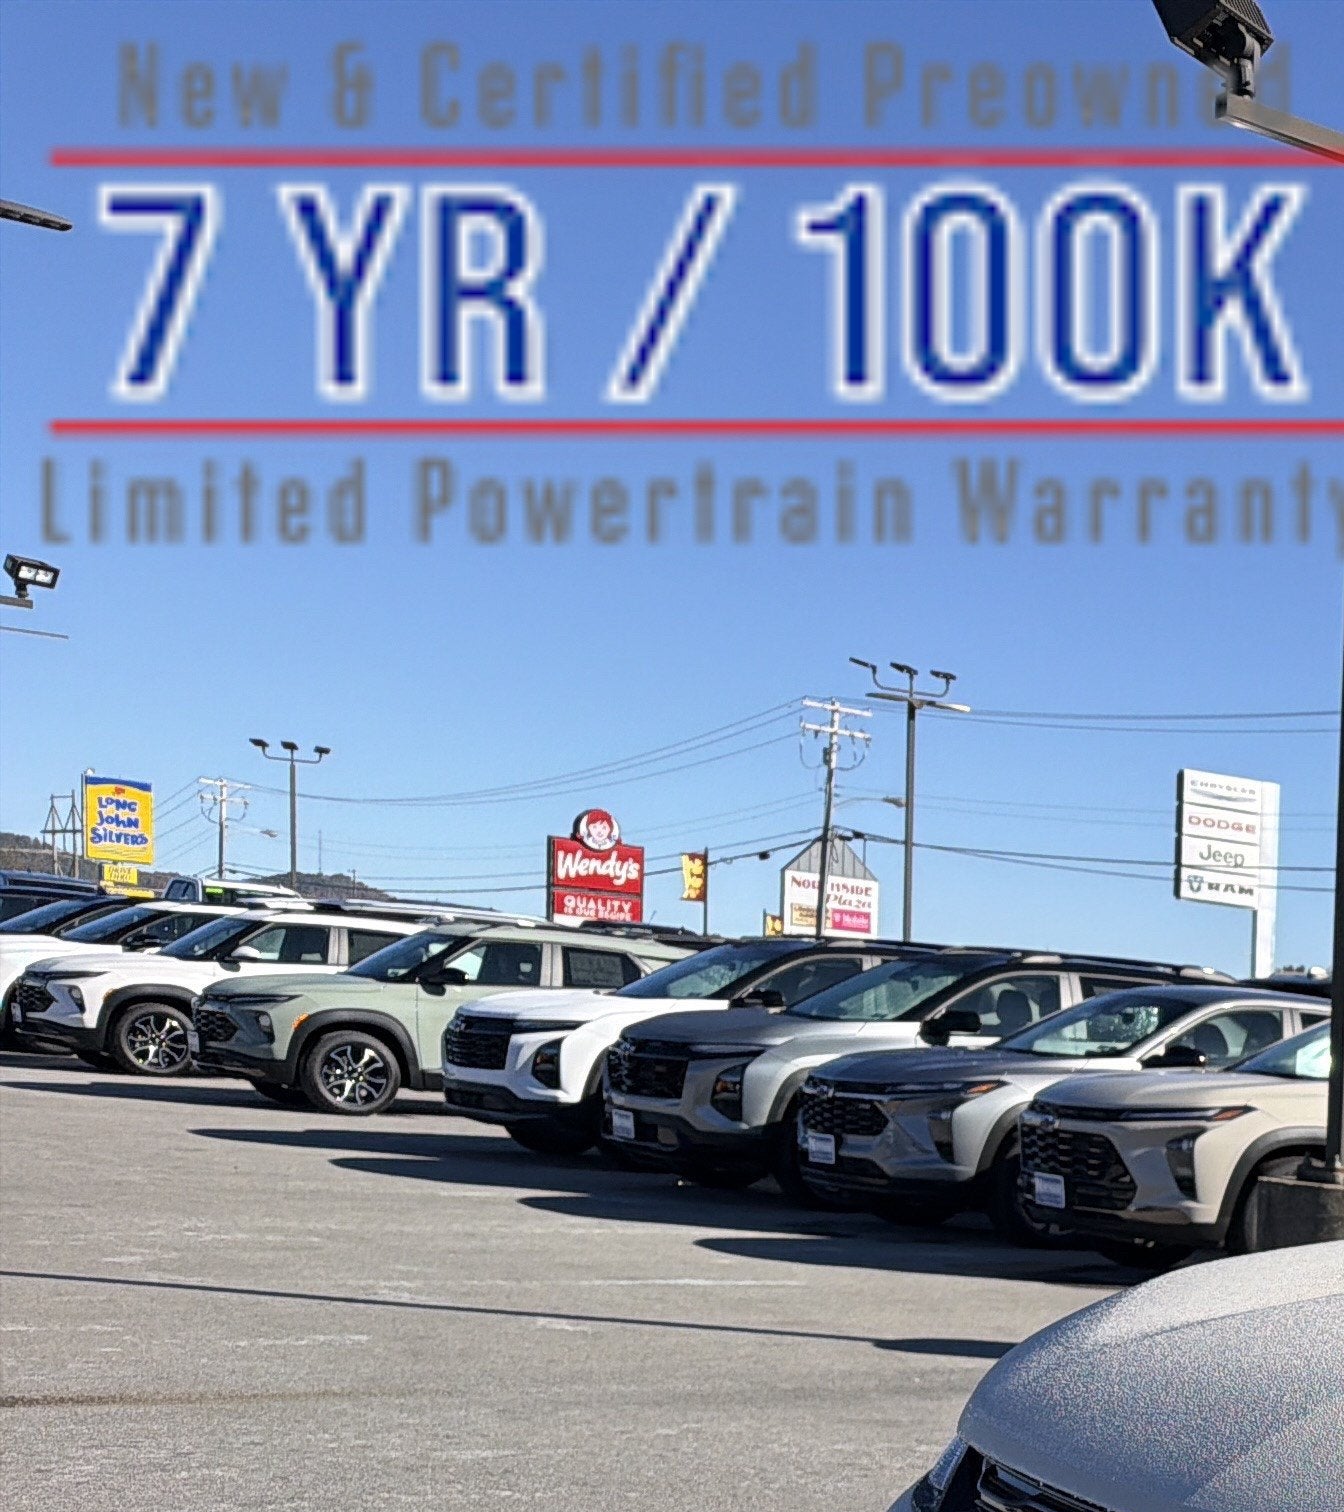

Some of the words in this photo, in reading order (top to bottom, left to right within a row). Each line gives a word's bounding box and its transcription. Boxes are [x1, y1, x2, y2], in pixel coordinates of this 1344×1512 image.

[1188, 815, 1257, 835] DODGE
[1199, 844, 1245, 868] Jeep
[557, 849, 641, 886] Wendy's
[1207, 882, 1254, 896] RAM
[563, 895, 632, 913] QUALITY
